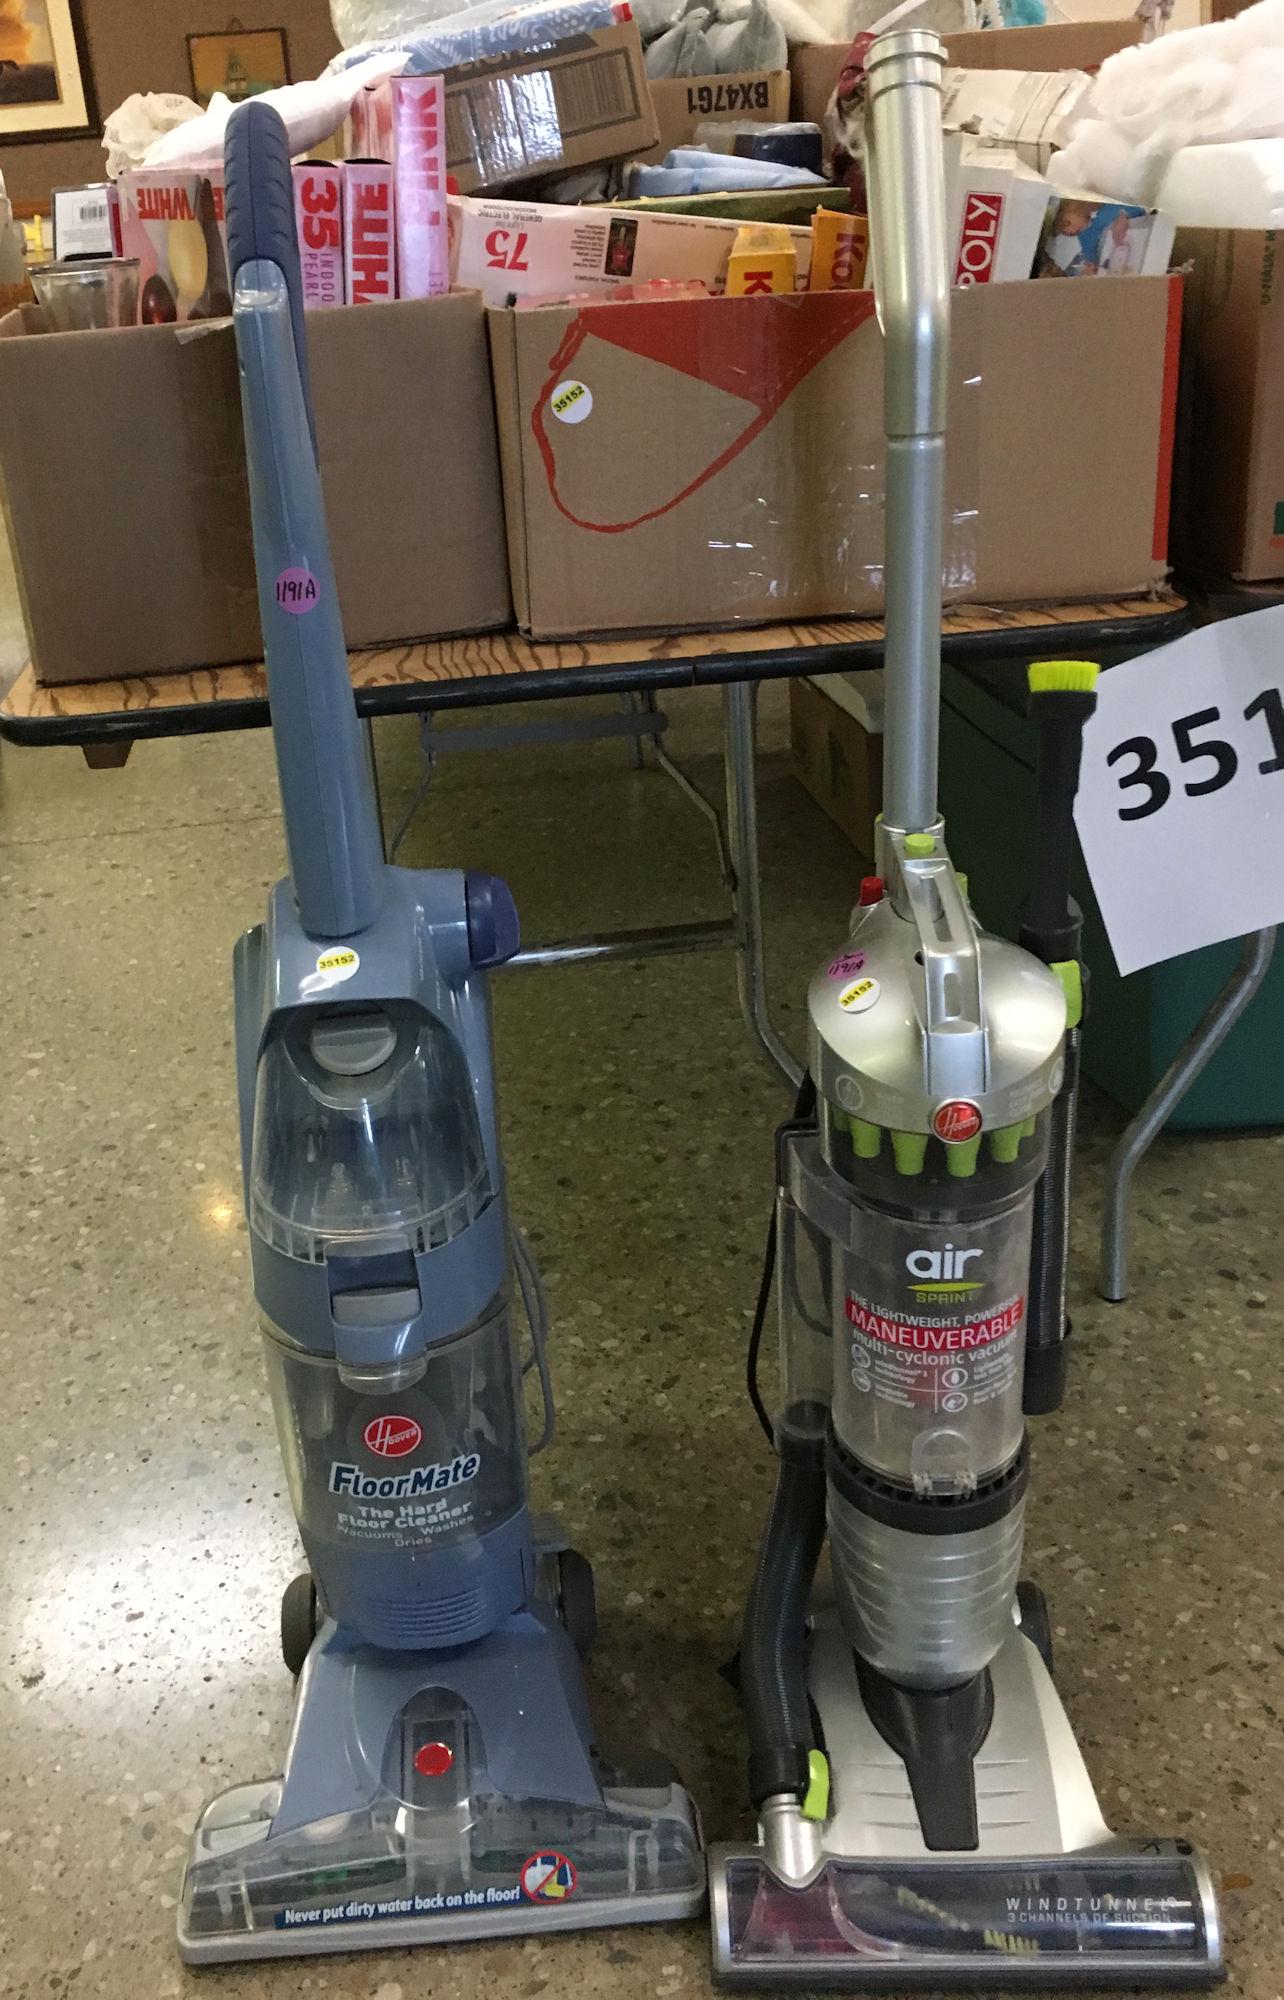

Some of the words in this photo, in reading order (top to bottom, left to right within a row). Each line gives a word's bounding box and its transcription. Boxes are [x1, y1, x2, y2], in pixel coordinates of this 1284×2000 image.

[687, 81, 769, 114] BX47G1
[136, 187, 195, 220] WHITE
[301, 177, 340, 249] 35
[485, 230, 529, 272] 75
[958, 197, 998, 285] POLY
[552, 384, 587, 414] 35152
[276, 578, 317, 603] 1191A
[320, 953, 356, 970] 35152
[840, 980, 874, 1007] 35152
[905, 1243, 984, 1279] air
[851, 1289, 868, 1310] THE
[915, 1291, 975, 1305] SPRINT
[851, 1304, 1021, 1350] MANEUVERABLE
[853, 1329, 965, 1366] multi-cyclonic
[968, 1329, 1018, 1361] vacuum
[330, 1454, 479, 1498] FloorMate
[337, 1512, 387, 1529] Floor
[394, 1501, 473, 1529] Cleaner
[357, 1505, 394, 1519] The
[400, 1498, 448, 1518] Hard
[420, 1514, 475, 1536] Washes
[394, 1536, 433, 1548] Dries
[285, 1909, 320, 1925] Never
[322, 1906, 345, 1923] put
[345, 1902, 376, 1919] dirty
[377, 1899, 414, 1914] water
[414, 1895, 446, 1909] back
[446, 1895, 463, 1907] on
[463, 1891, 485, 1905] the
[486, 1885, 521, 1902] floor!
[1007, 1912, 1016, 1923] 3
[1019, 1912, 1088, 1923] CHANNELS
[1093, 1912, 1109, 1923] OF
